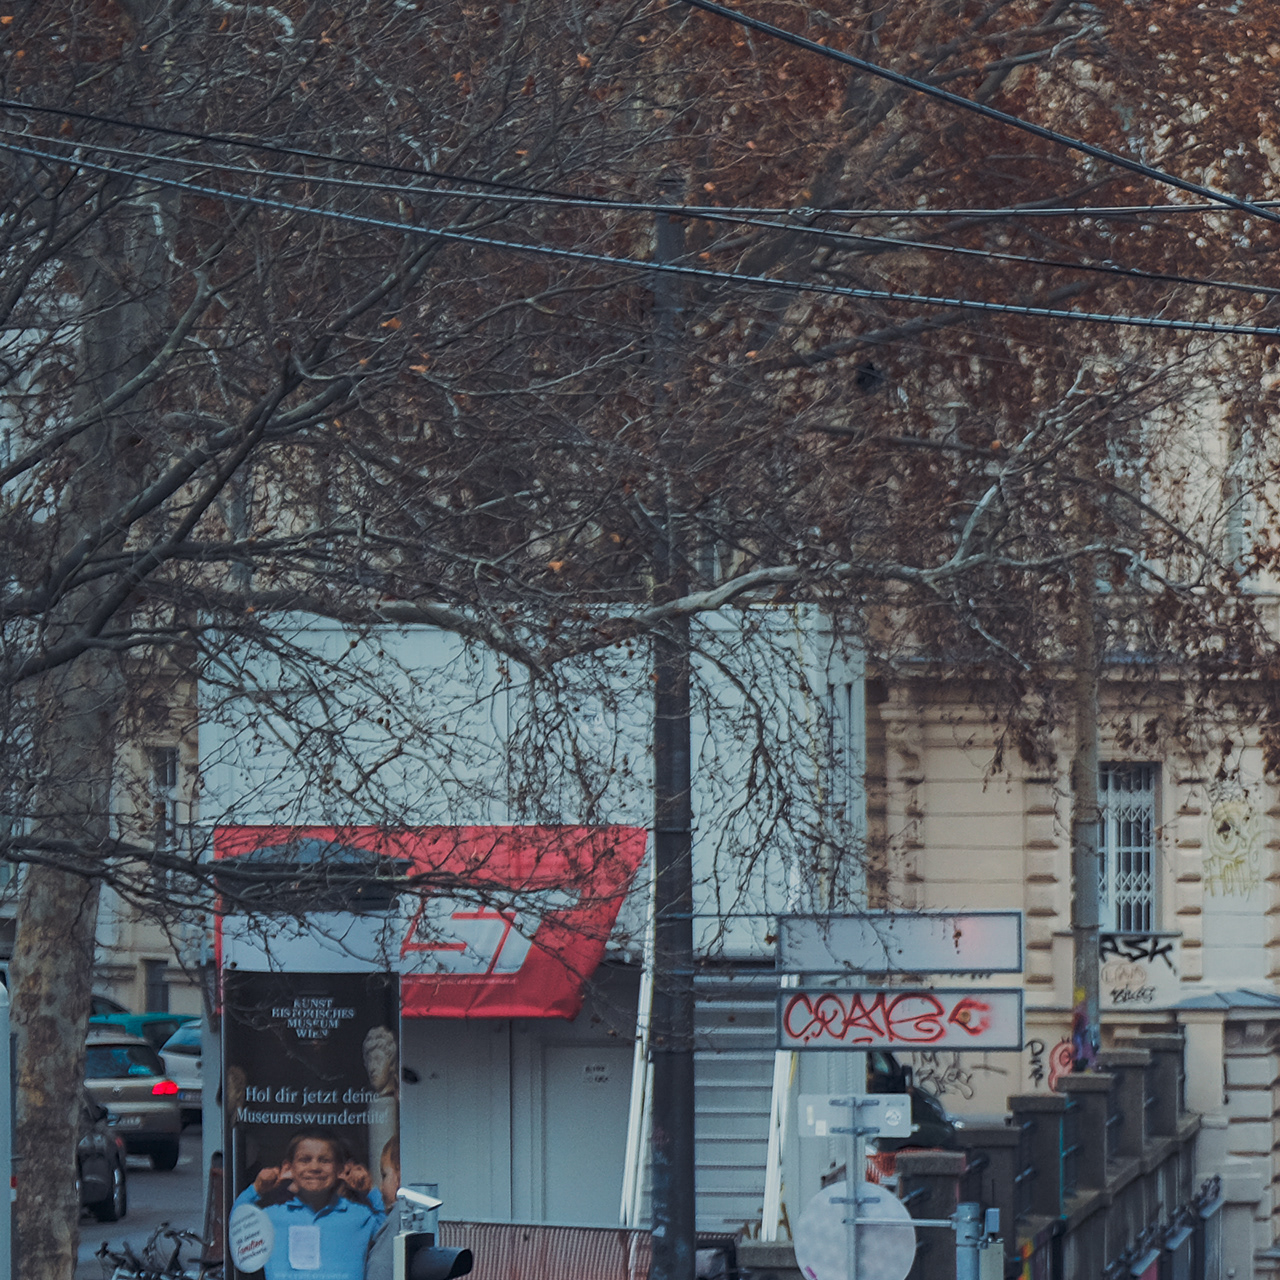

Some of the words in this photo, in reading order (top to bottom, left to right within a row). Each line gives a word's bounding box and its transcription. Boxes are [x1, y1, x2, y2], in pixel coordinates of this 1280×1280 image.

[293, 997, 334, 1008] KUNST
[271, 1007, 354, 1018] HISTORISCHES
[287, 1019, 339, 1029] MUSEUM
[296, 1029, 328, 1038] WIEN
[245, 1085, 271, 1103] Hol
[275, 1086, 298, 1103] dir
[302, 1087, 338, 1107] jetzt
[342, 1085, 379, 1104] deine
